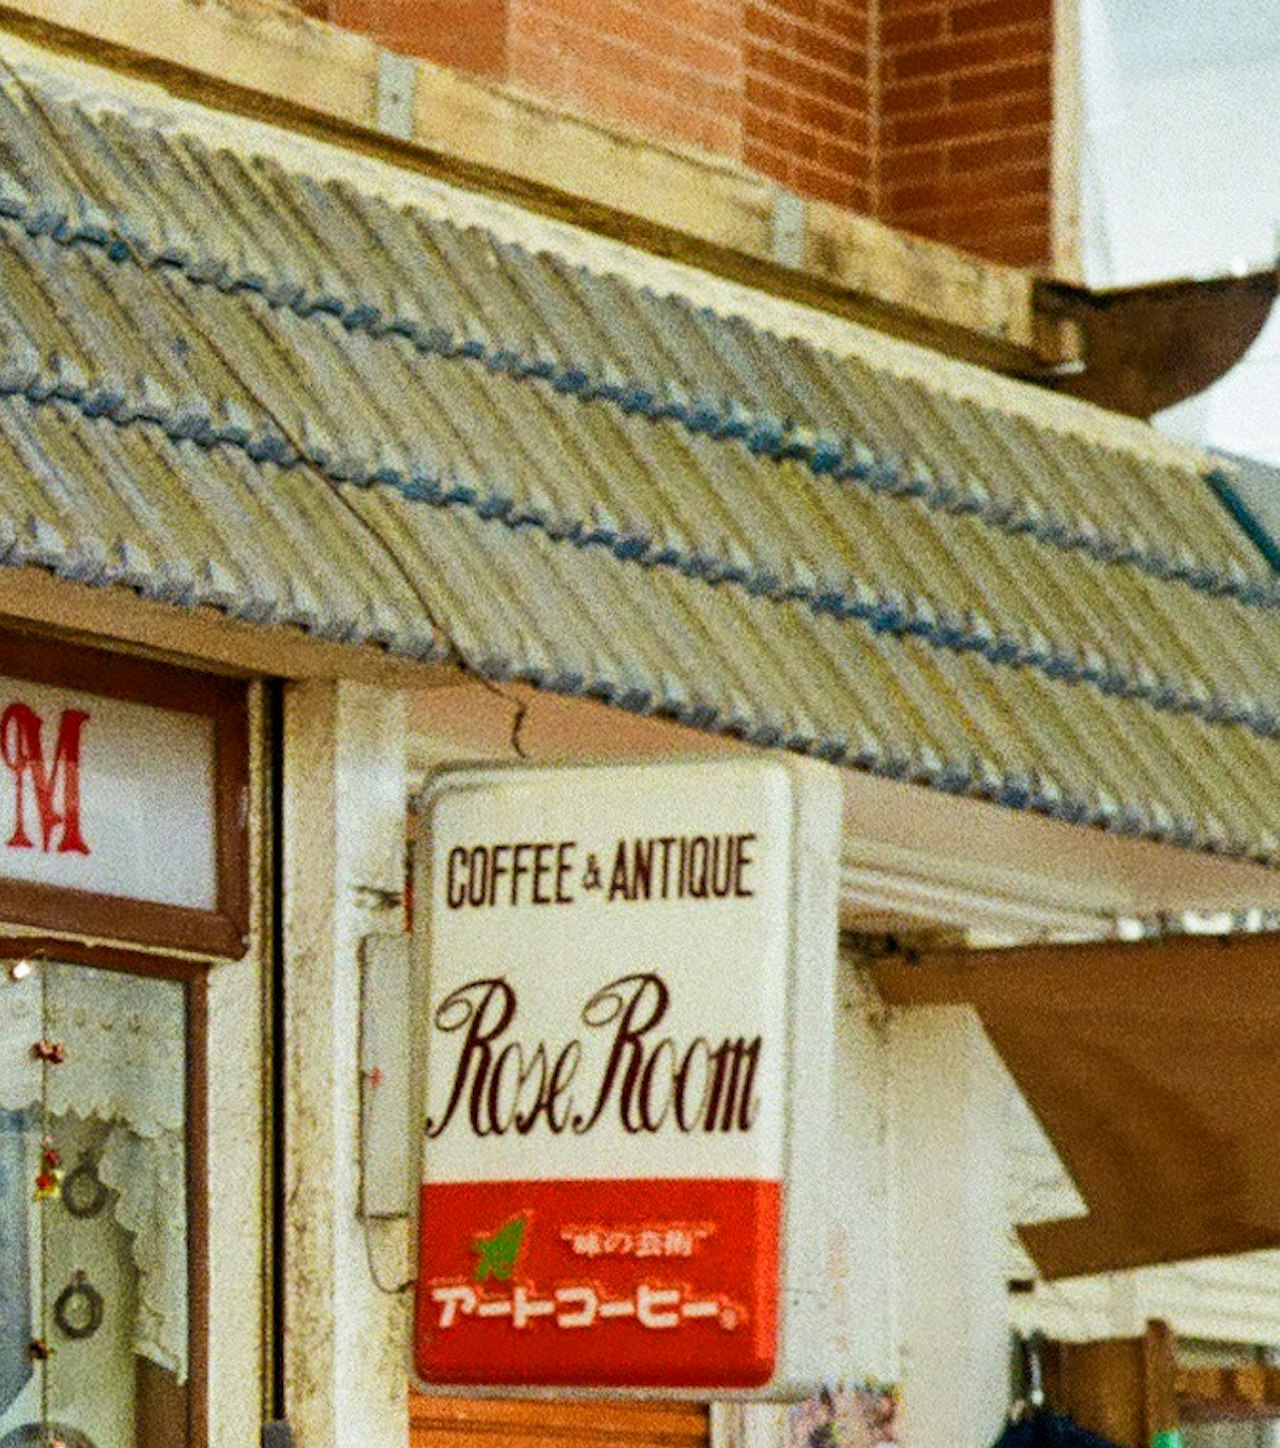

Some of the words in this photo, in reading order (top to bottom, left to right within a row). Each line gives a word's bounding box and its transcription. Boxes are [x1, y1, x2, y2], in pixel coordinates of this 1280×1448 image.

[446, 841, 577, 910] COFFEE
[609, 832, 758, 904] ANTIQUE
[426, 975, 582, 1140] Rose
[574, 970, 764, 1135] Room
[431, 1283, 719, 1330] アートコーヒー
